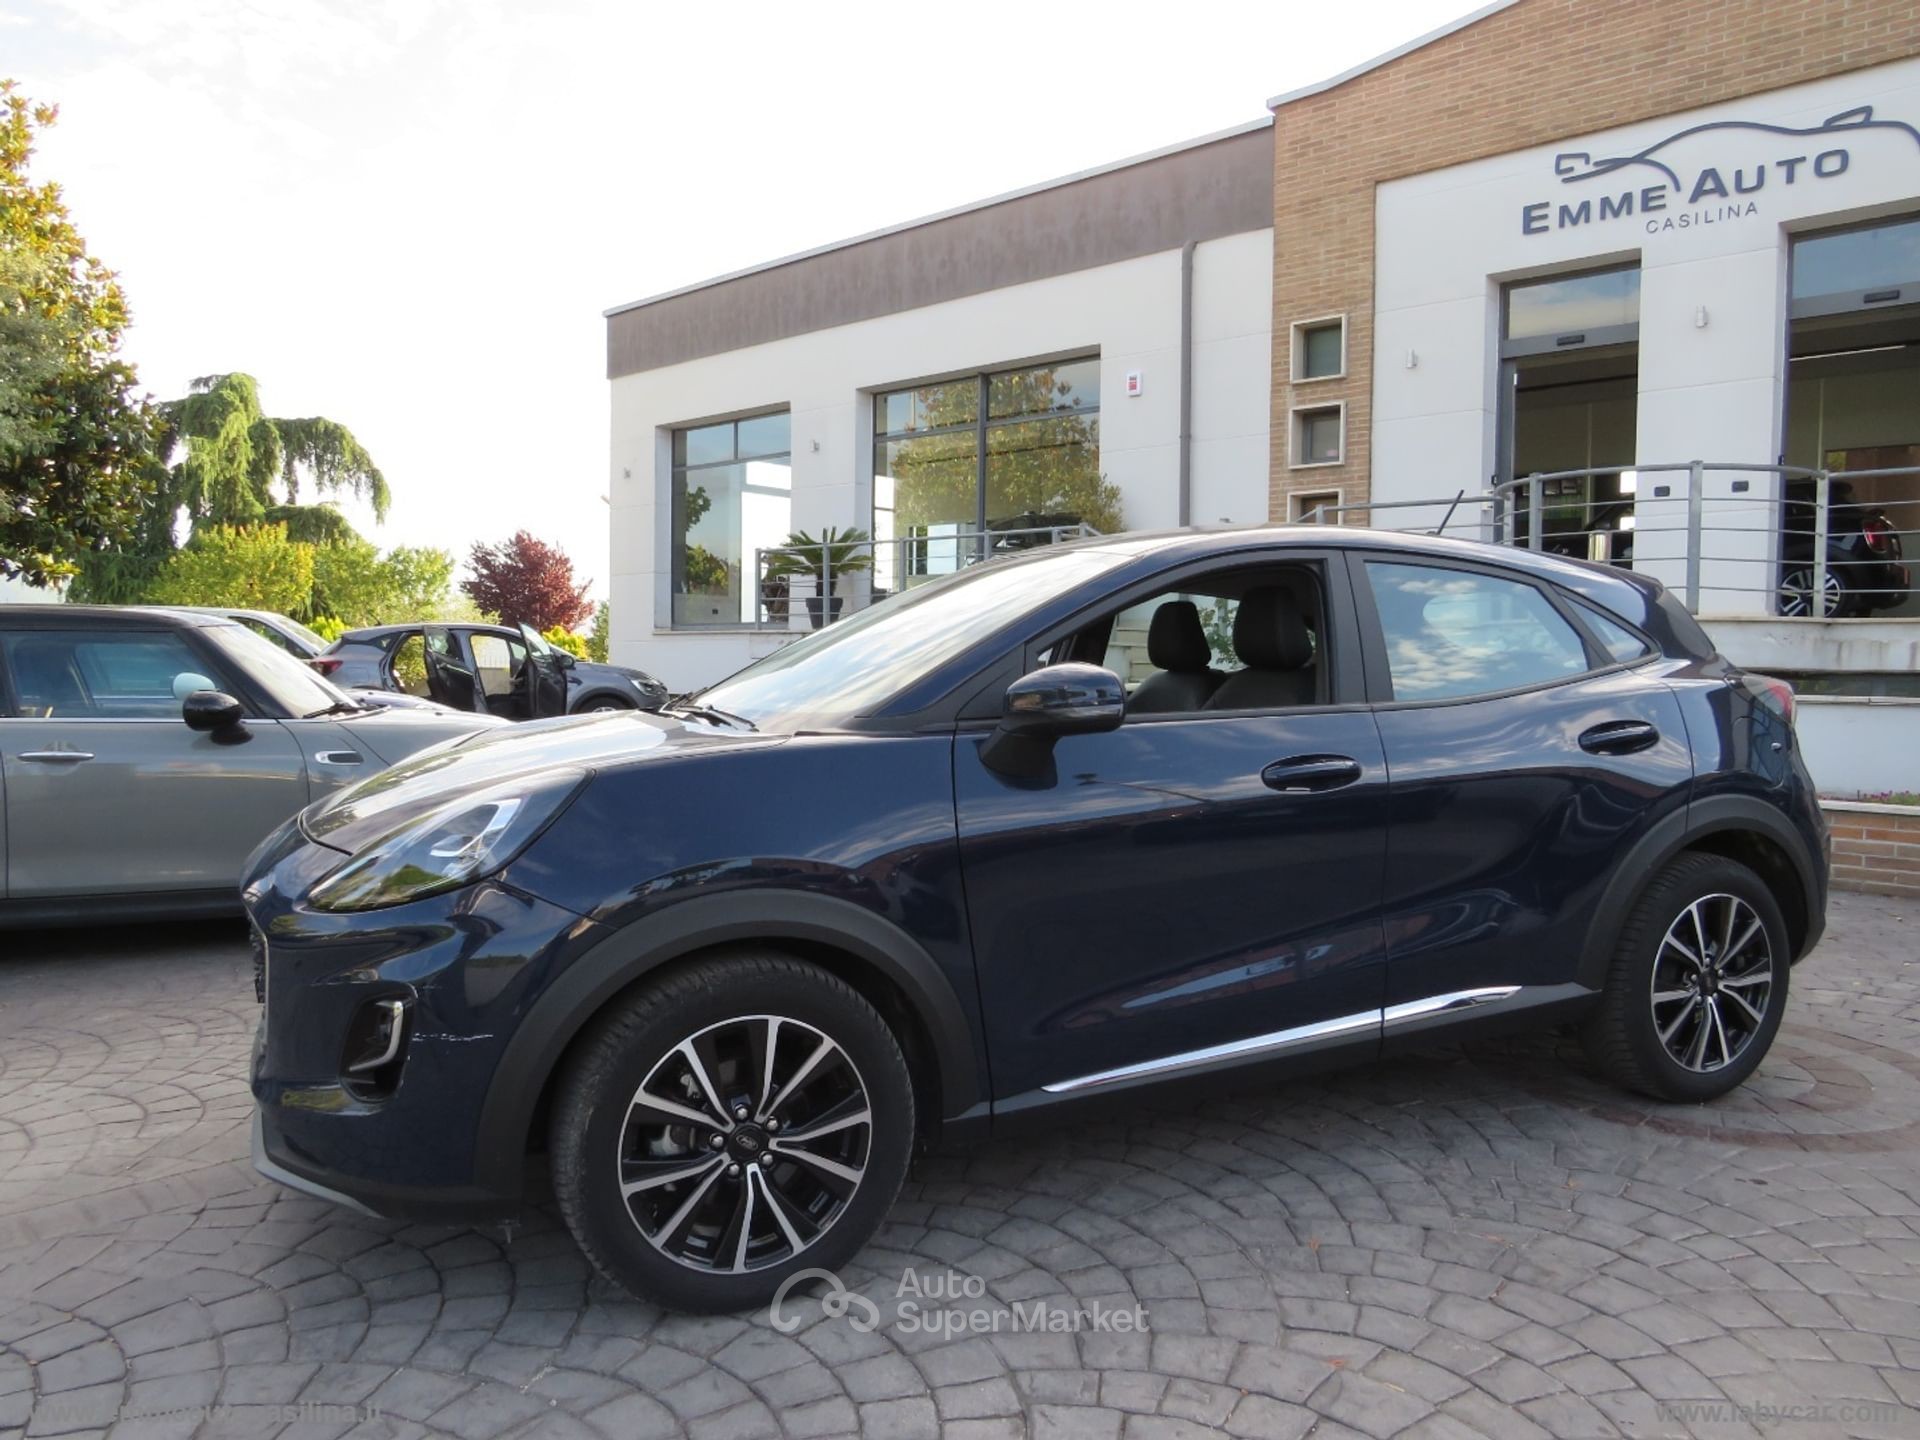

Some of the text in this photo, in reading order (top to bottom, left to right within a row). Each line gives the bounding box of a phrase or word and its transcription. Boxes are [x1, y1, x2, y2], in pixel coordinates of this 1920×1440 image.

[1522, 149, 1850, 235] EMME AUTO
[1645, 202, 1758, 234] CASILINA
